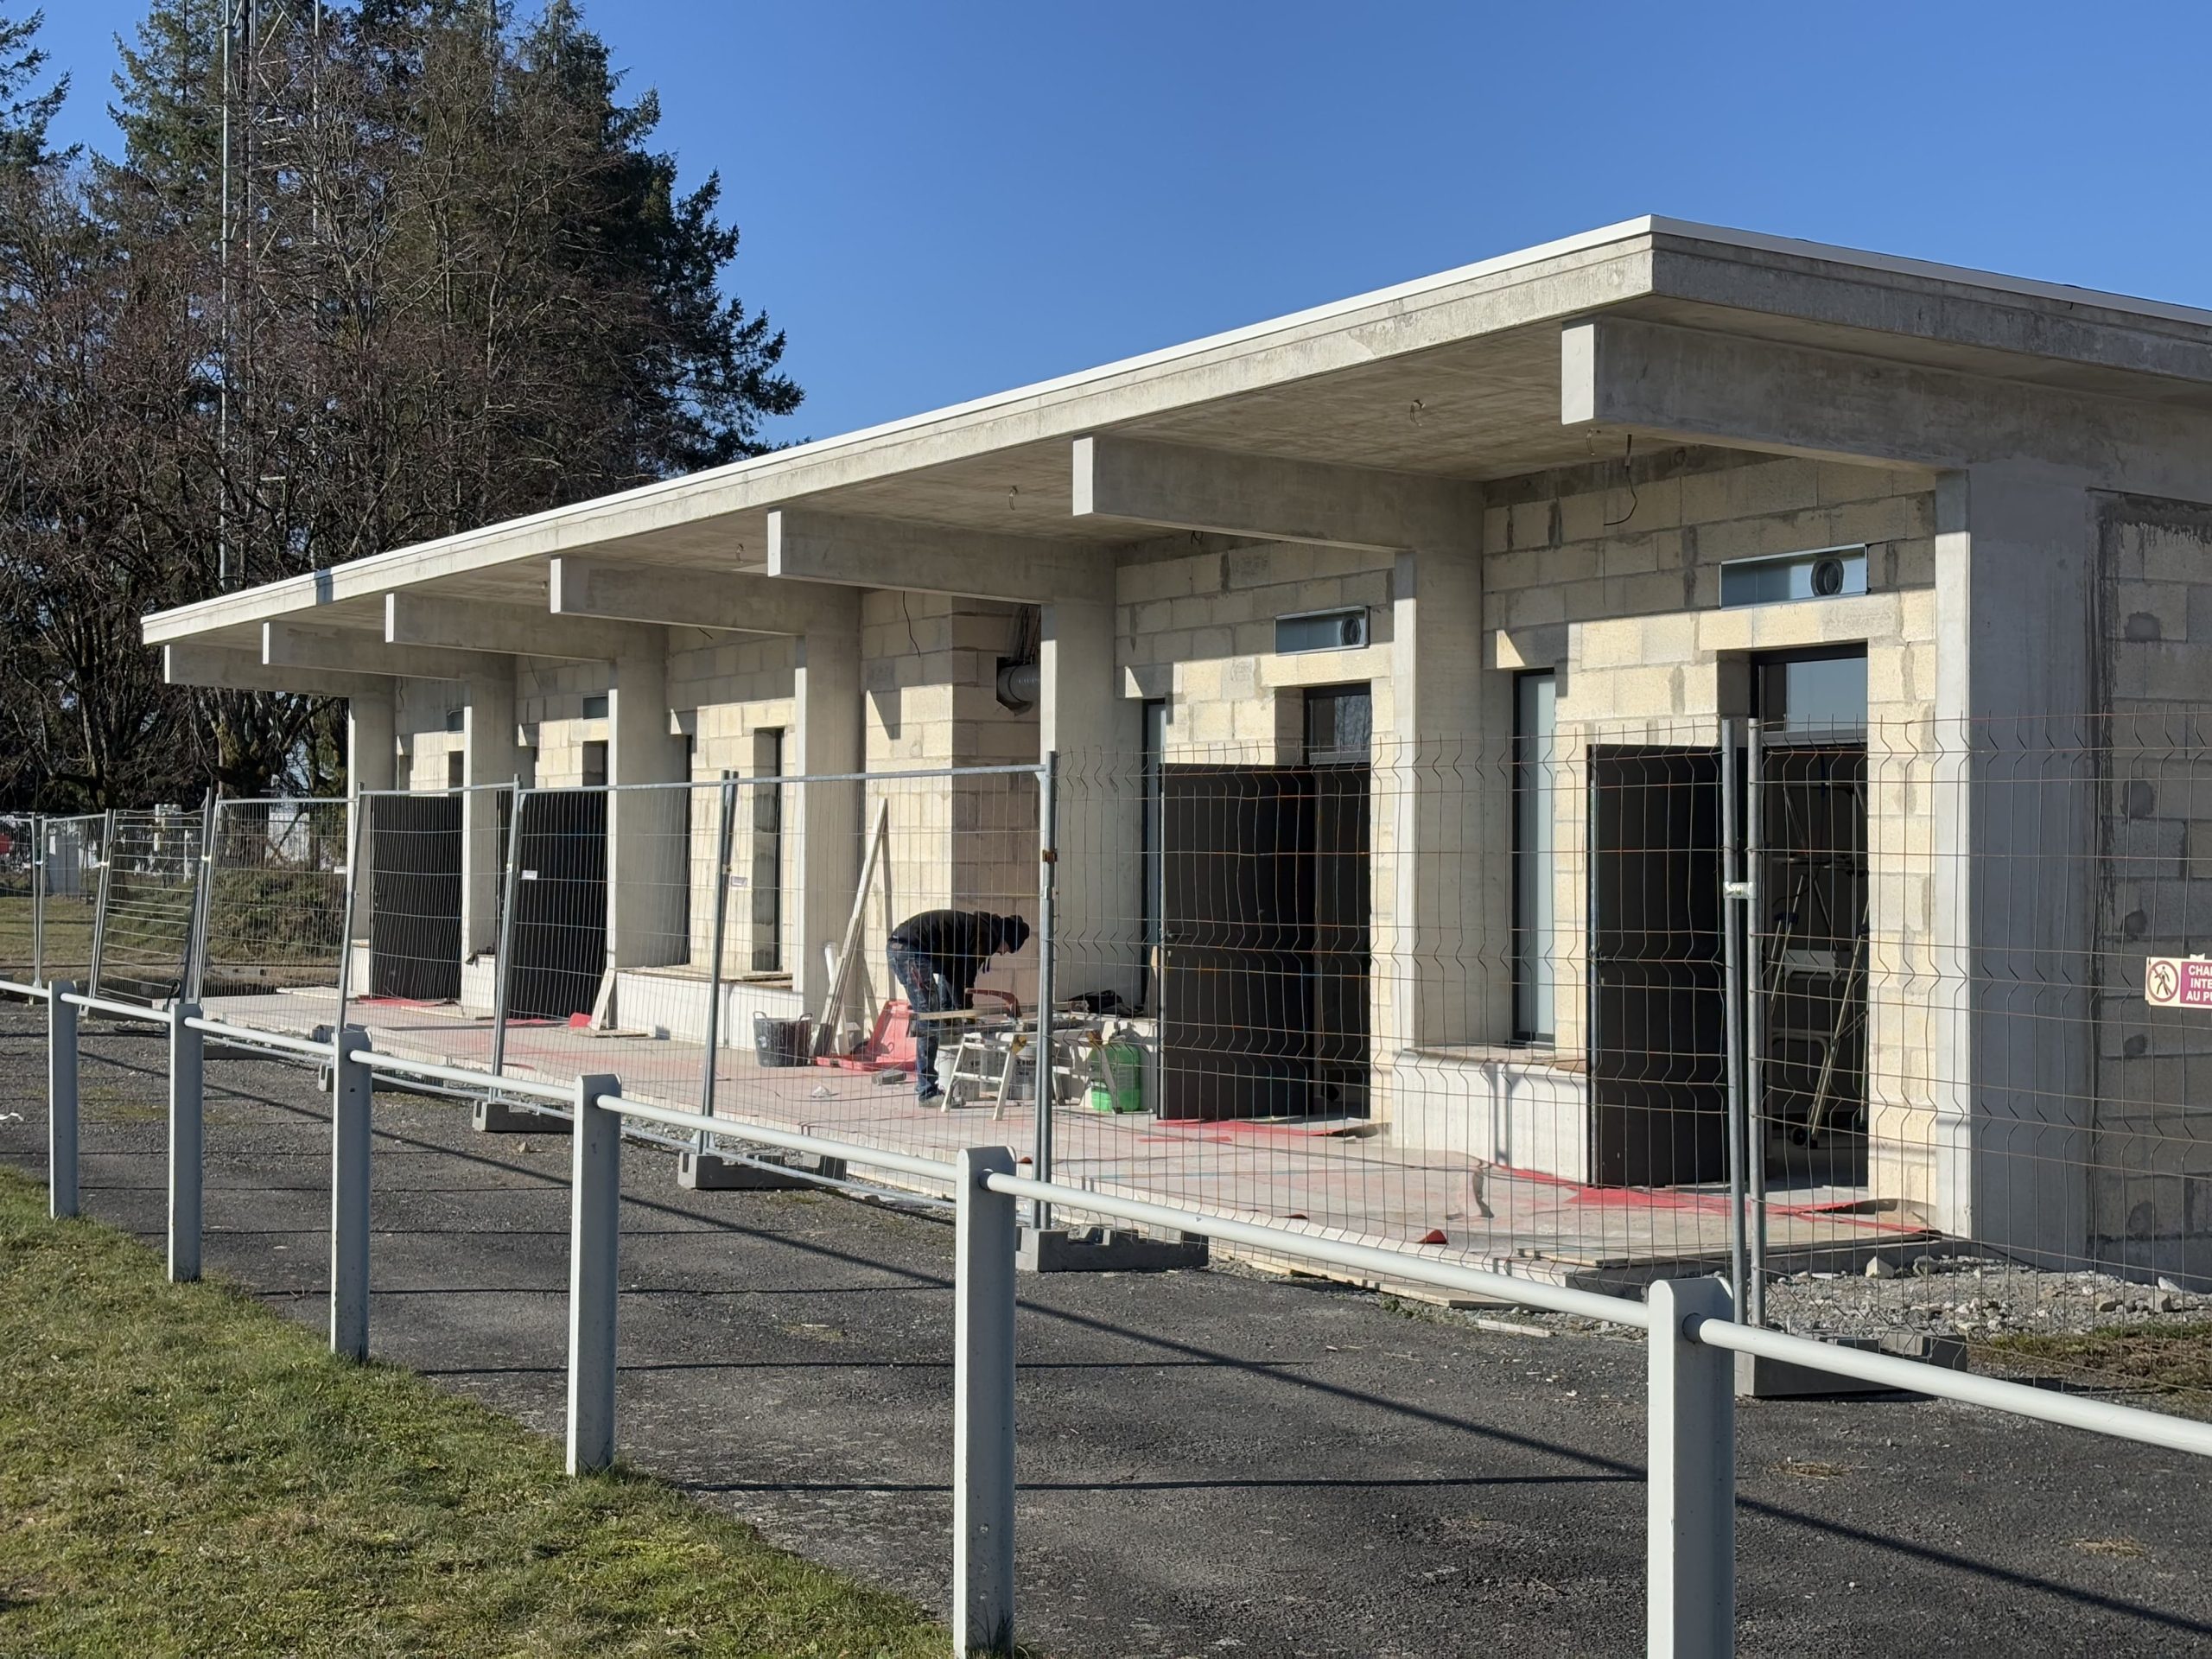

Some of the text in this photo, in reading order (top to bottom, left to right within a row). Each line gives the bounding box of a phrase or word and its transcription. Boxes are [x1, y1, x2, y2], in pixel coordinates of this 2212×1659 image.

[2188, 964, 2212, 976] CHA
[2185, 990, 2212, 1002] AU P
